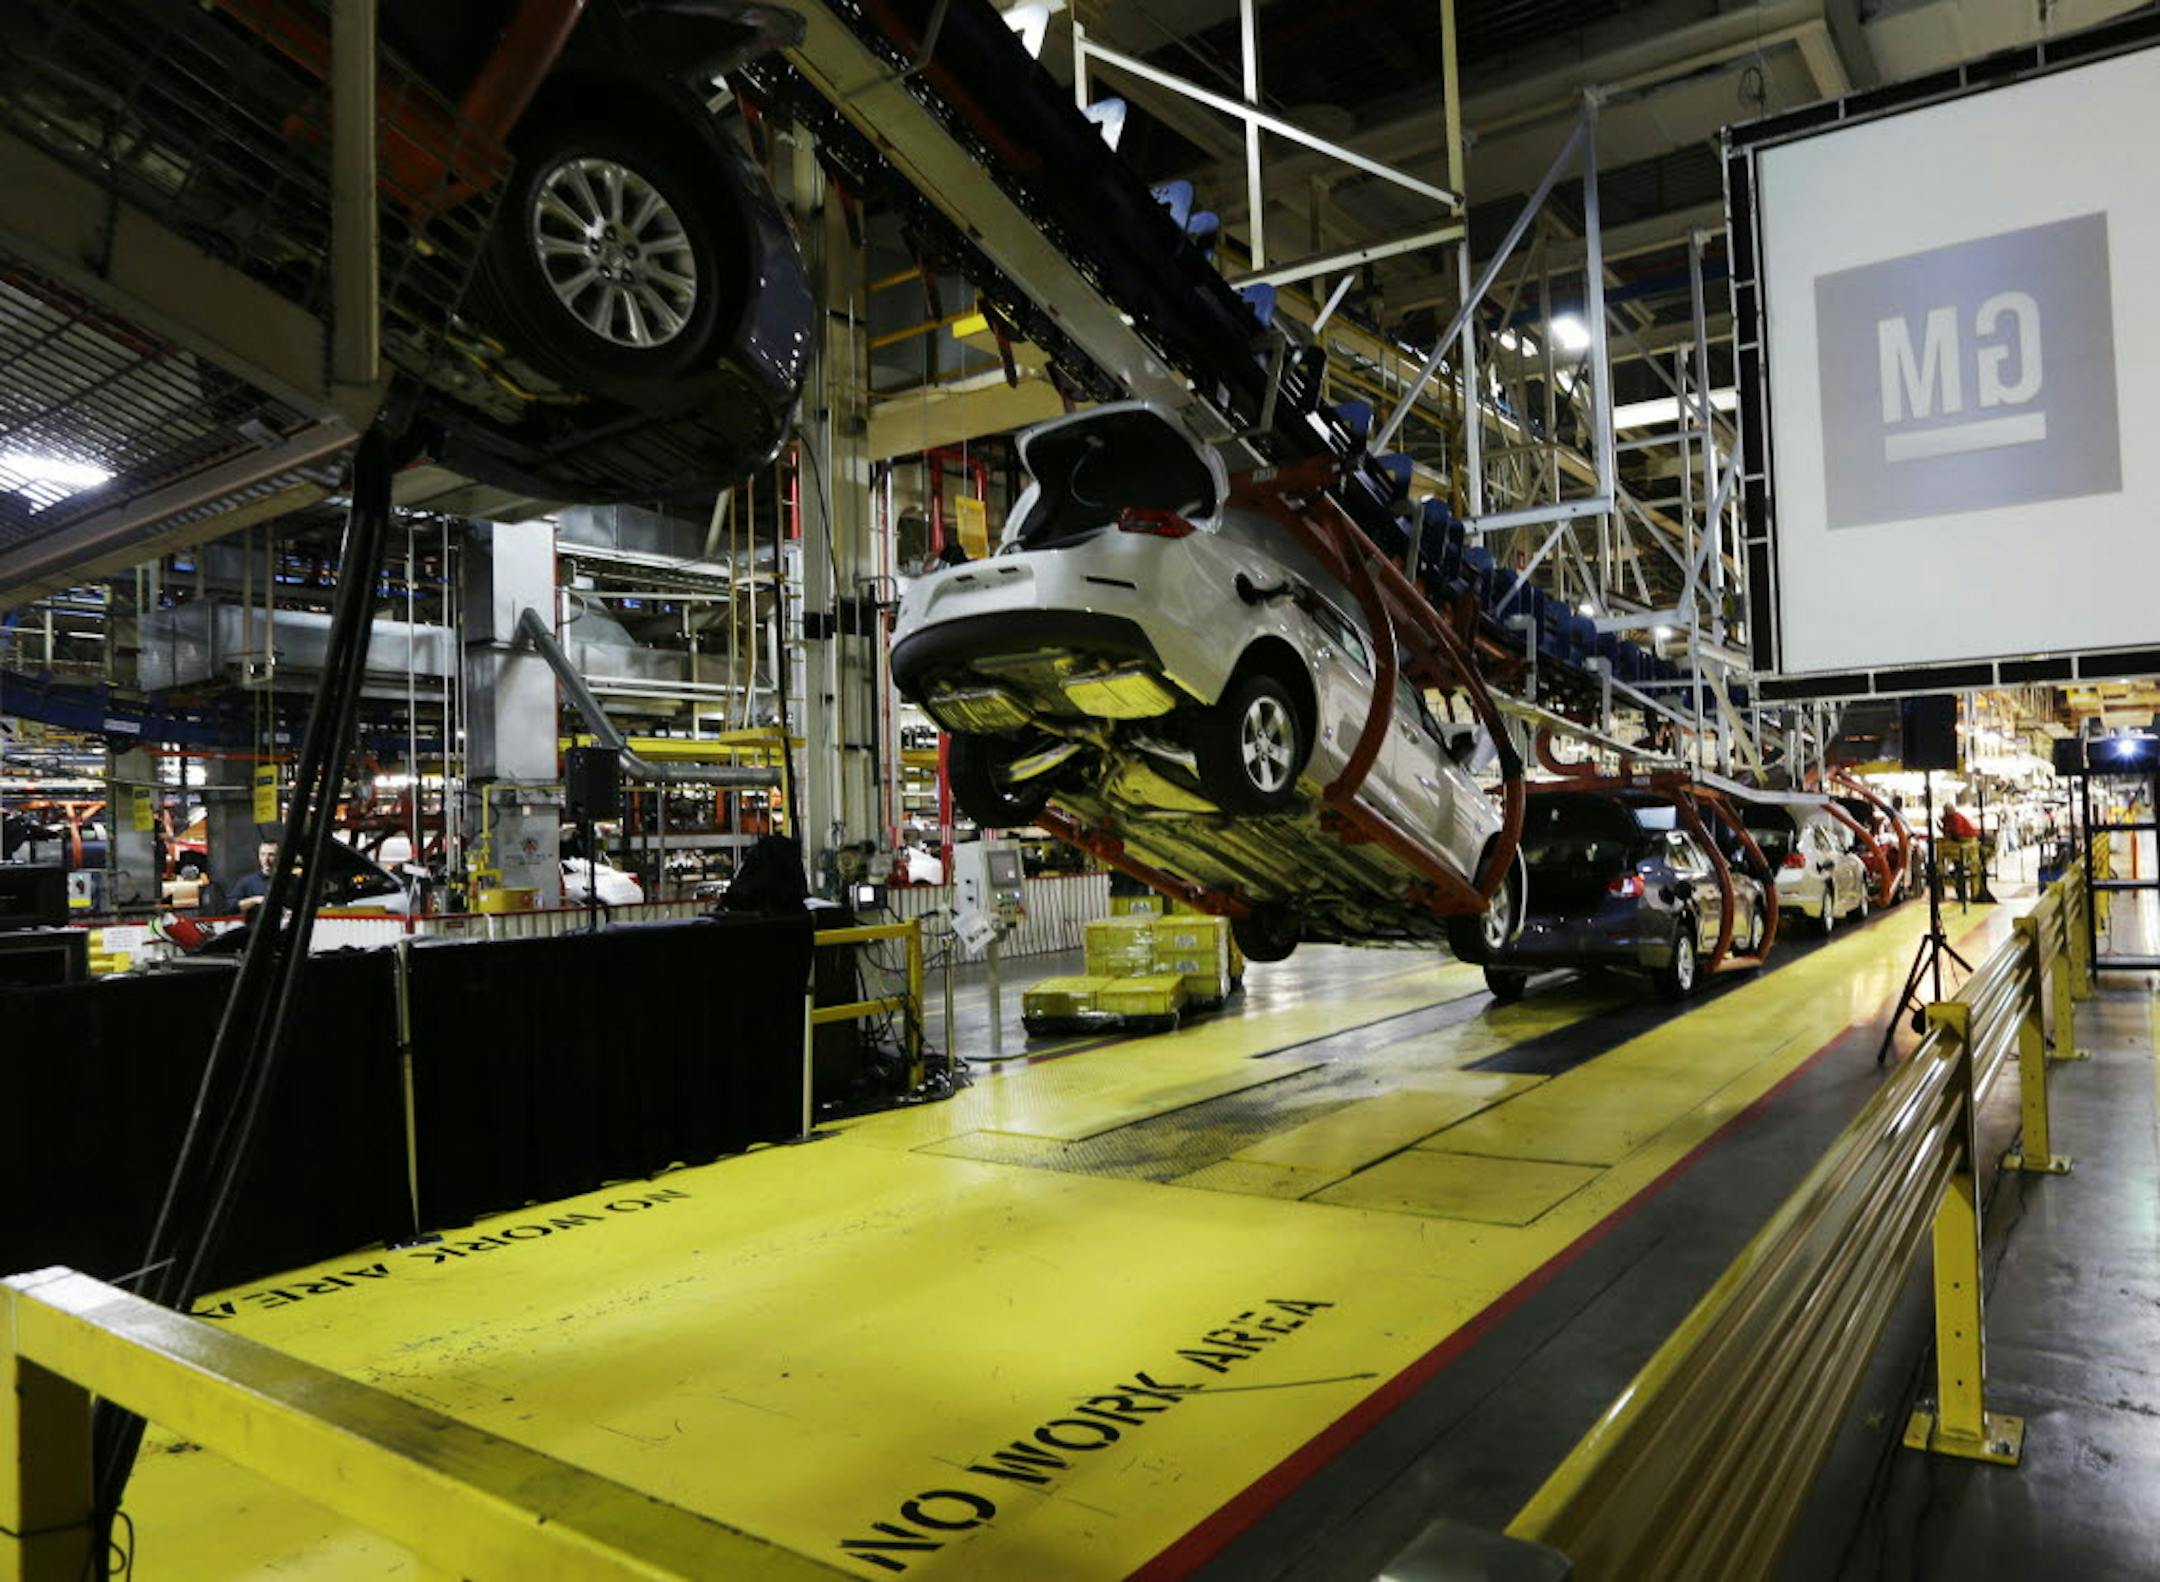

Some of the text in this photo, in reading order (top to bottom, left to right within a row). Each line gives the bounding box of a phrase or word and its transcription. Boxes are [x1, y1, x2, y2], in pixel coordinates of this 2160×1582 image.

[189, 1189, 692, 1319] NO WORK AREA
[840, 1299, 1335, 1573] NO WORK AREA
